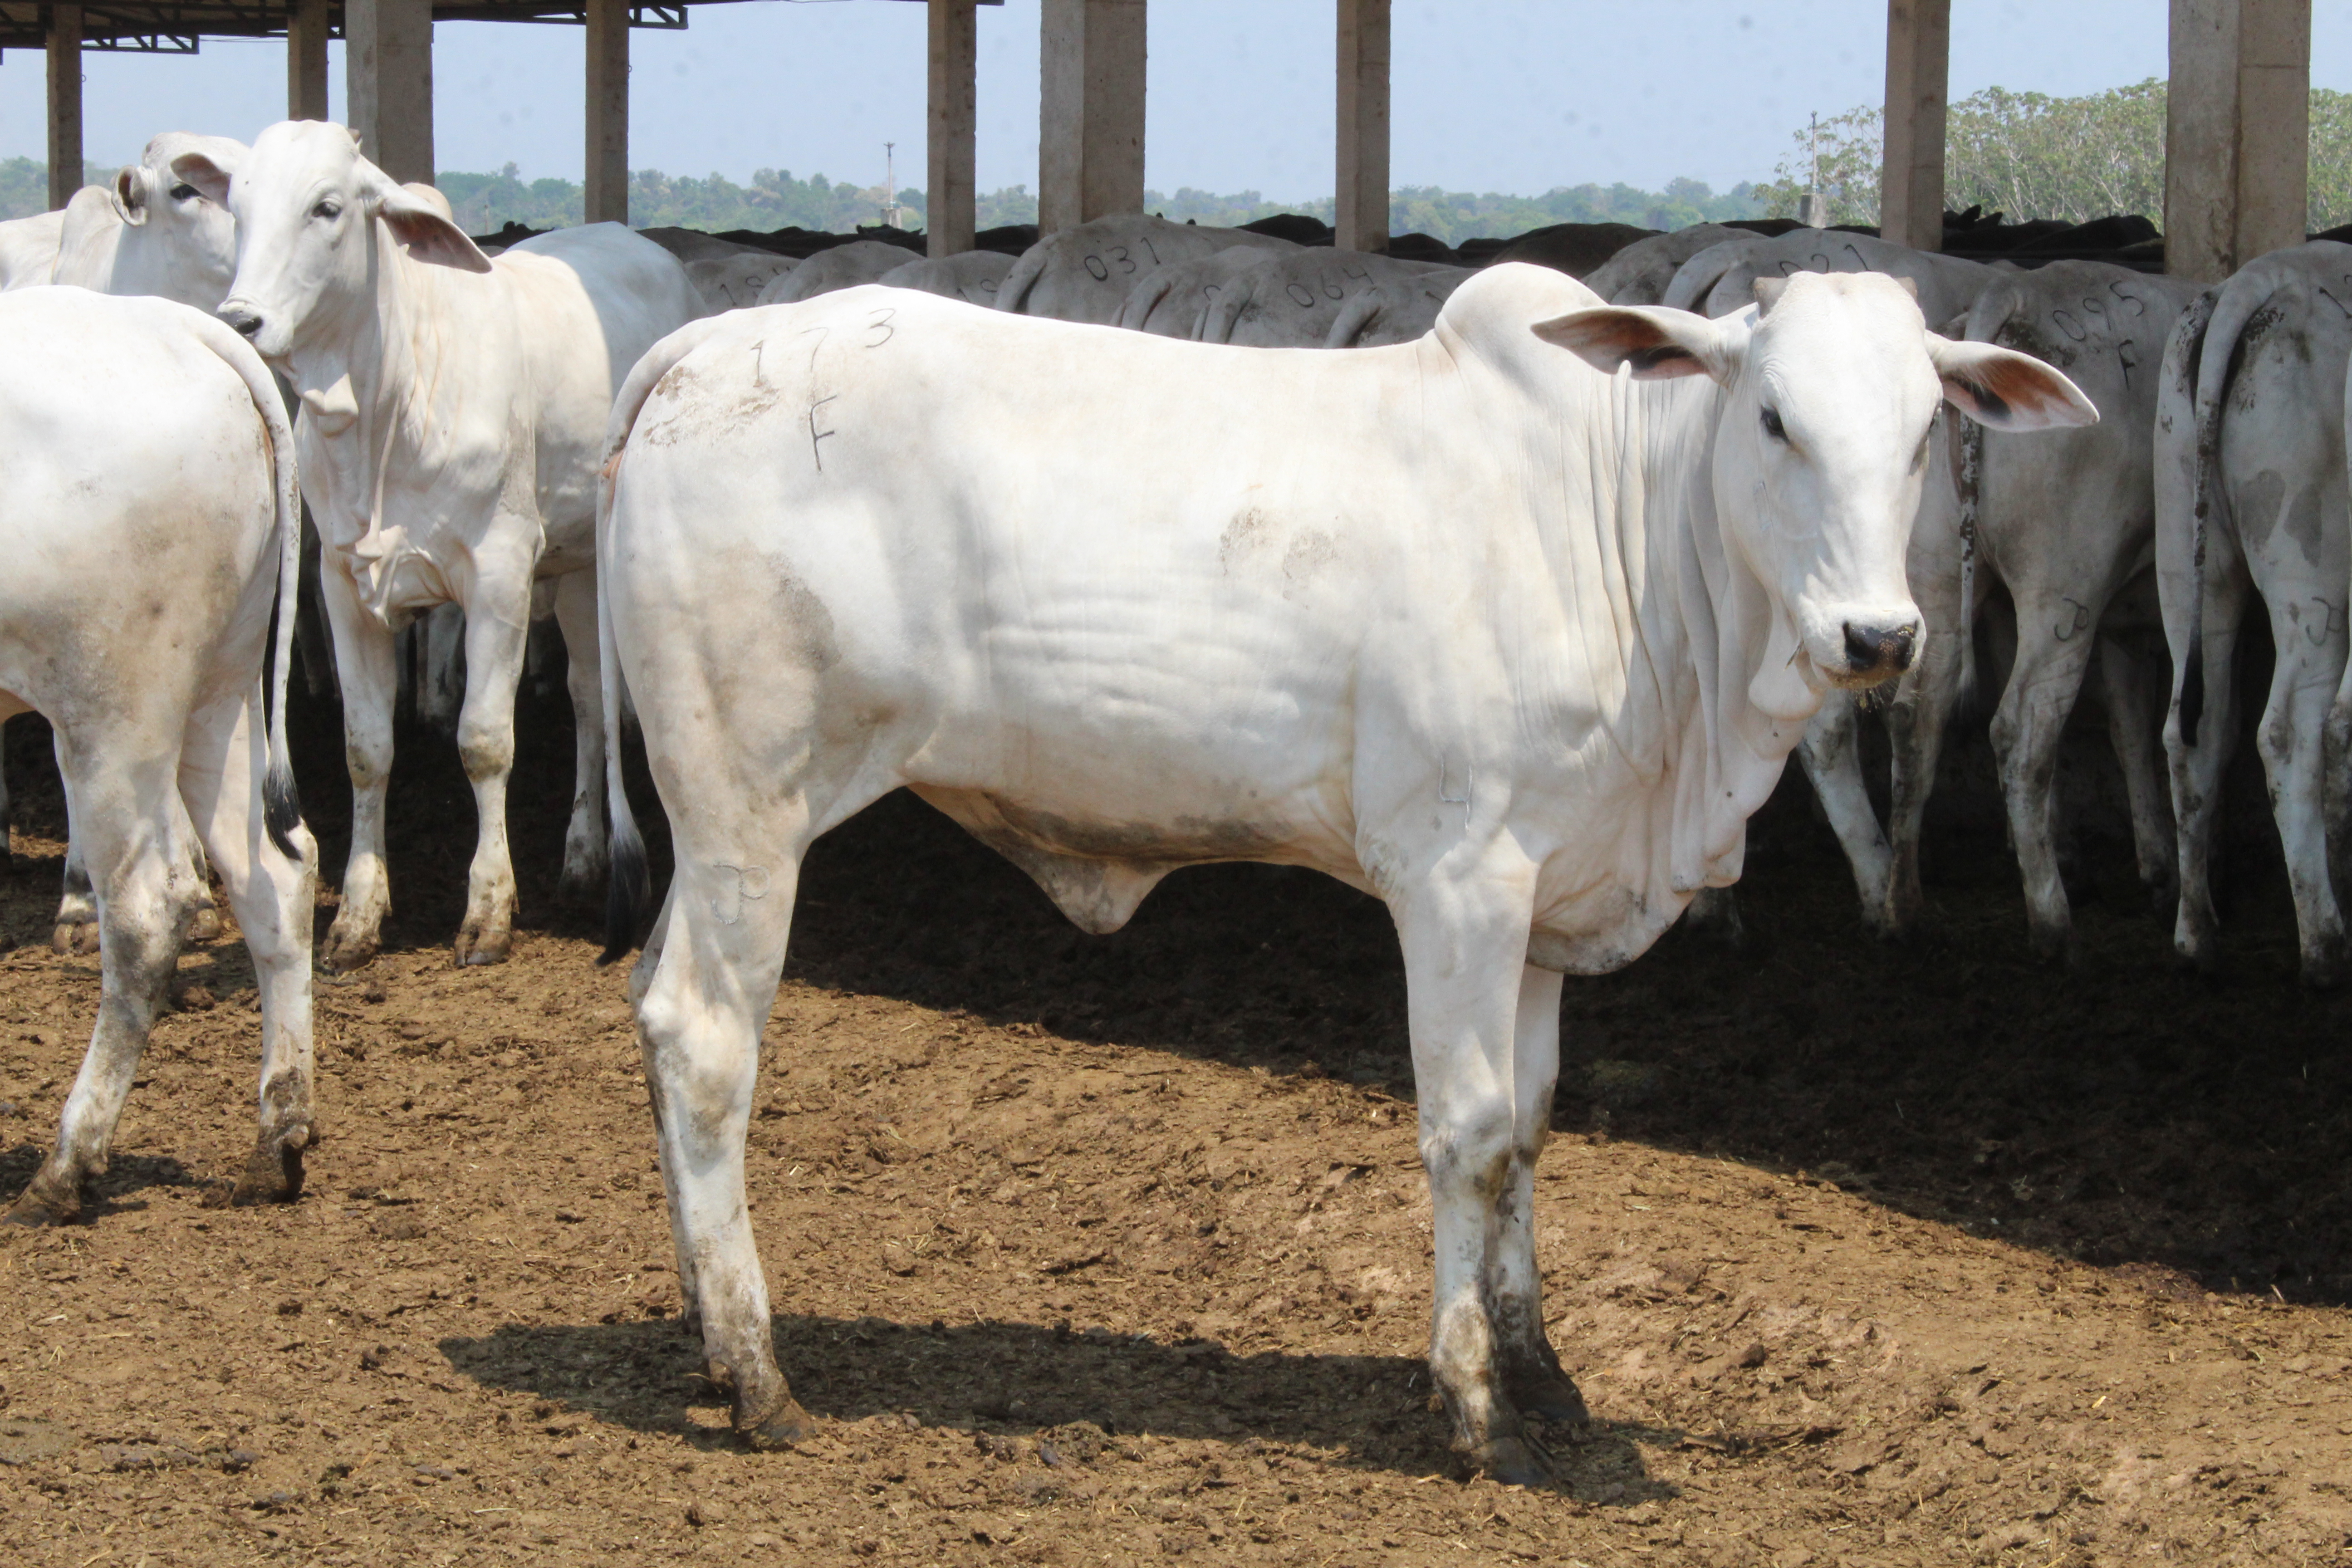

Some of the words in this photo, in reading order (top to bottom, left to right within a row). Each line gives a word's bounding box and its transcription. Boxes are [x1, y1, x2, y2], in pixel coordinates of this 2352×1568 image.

[1084, 237, 1161, 282] 031
[1286, 267, 1374, 308] 064
[2053, 279, 2144, 342] 095
[750, 308, 897, 388] 173
